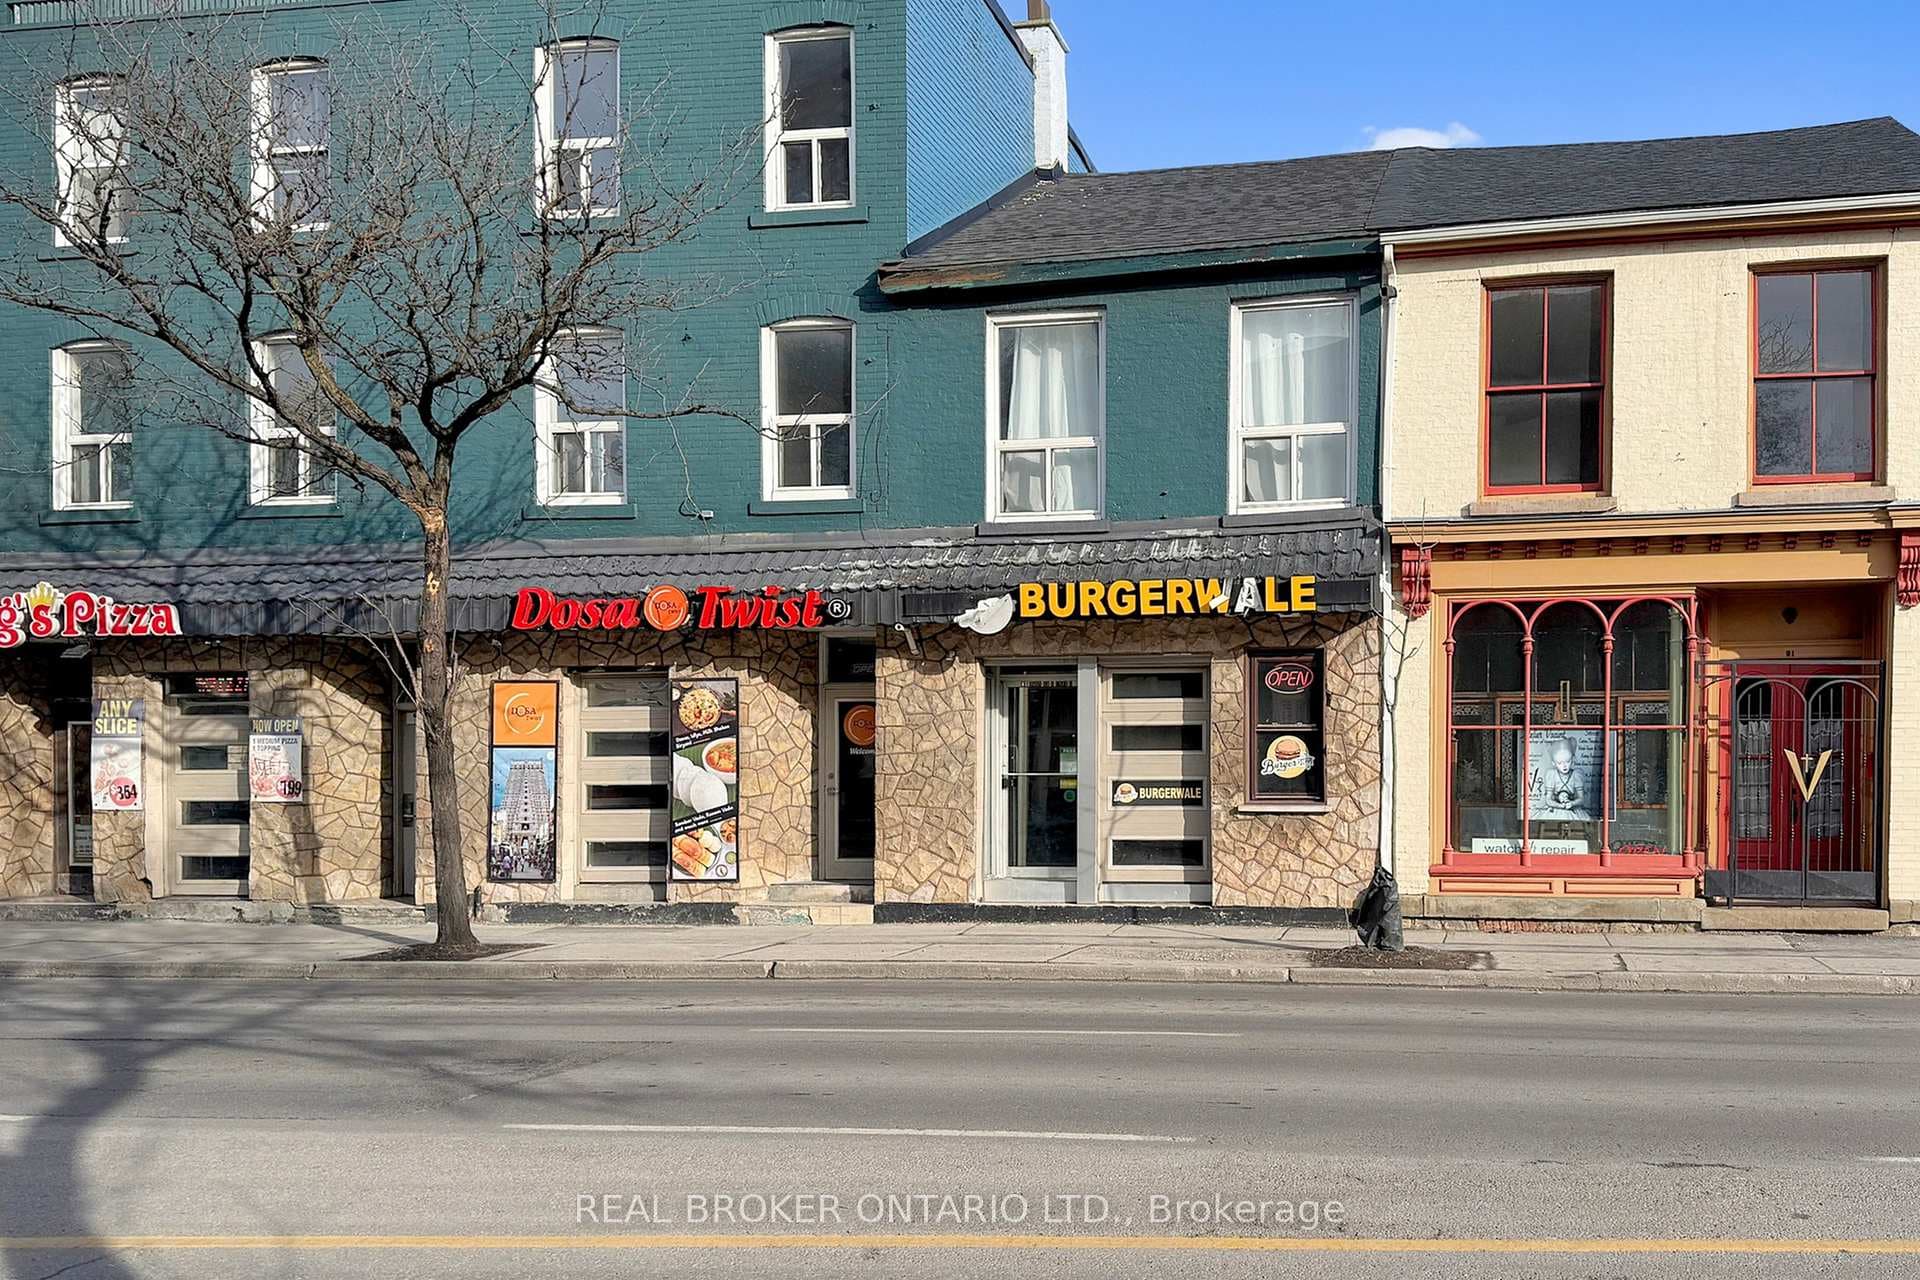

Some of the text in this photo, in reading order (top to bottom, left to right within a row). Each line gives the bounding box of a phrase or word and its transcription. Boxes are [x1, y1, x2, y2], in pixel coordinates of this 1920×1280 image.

[1019, 575, 1317, 618] BURGERWALE
[61, 591, 179, 637] Pizza
[511, 586, 641, 630] Dosa
[696, 585, 822, 629] Twist
[1268, 671, 1309, 686] OPEN
[98, 700, 133, 718] ANY
[95, 718, 138, 735] SLICE
[251, 719, 299, 733] NOW OPEN
[1783, 748, 1832, 803] V
[1139, 787, 1202, 799] BURGERWALE
[1540, 843, 1576, 854] repair
